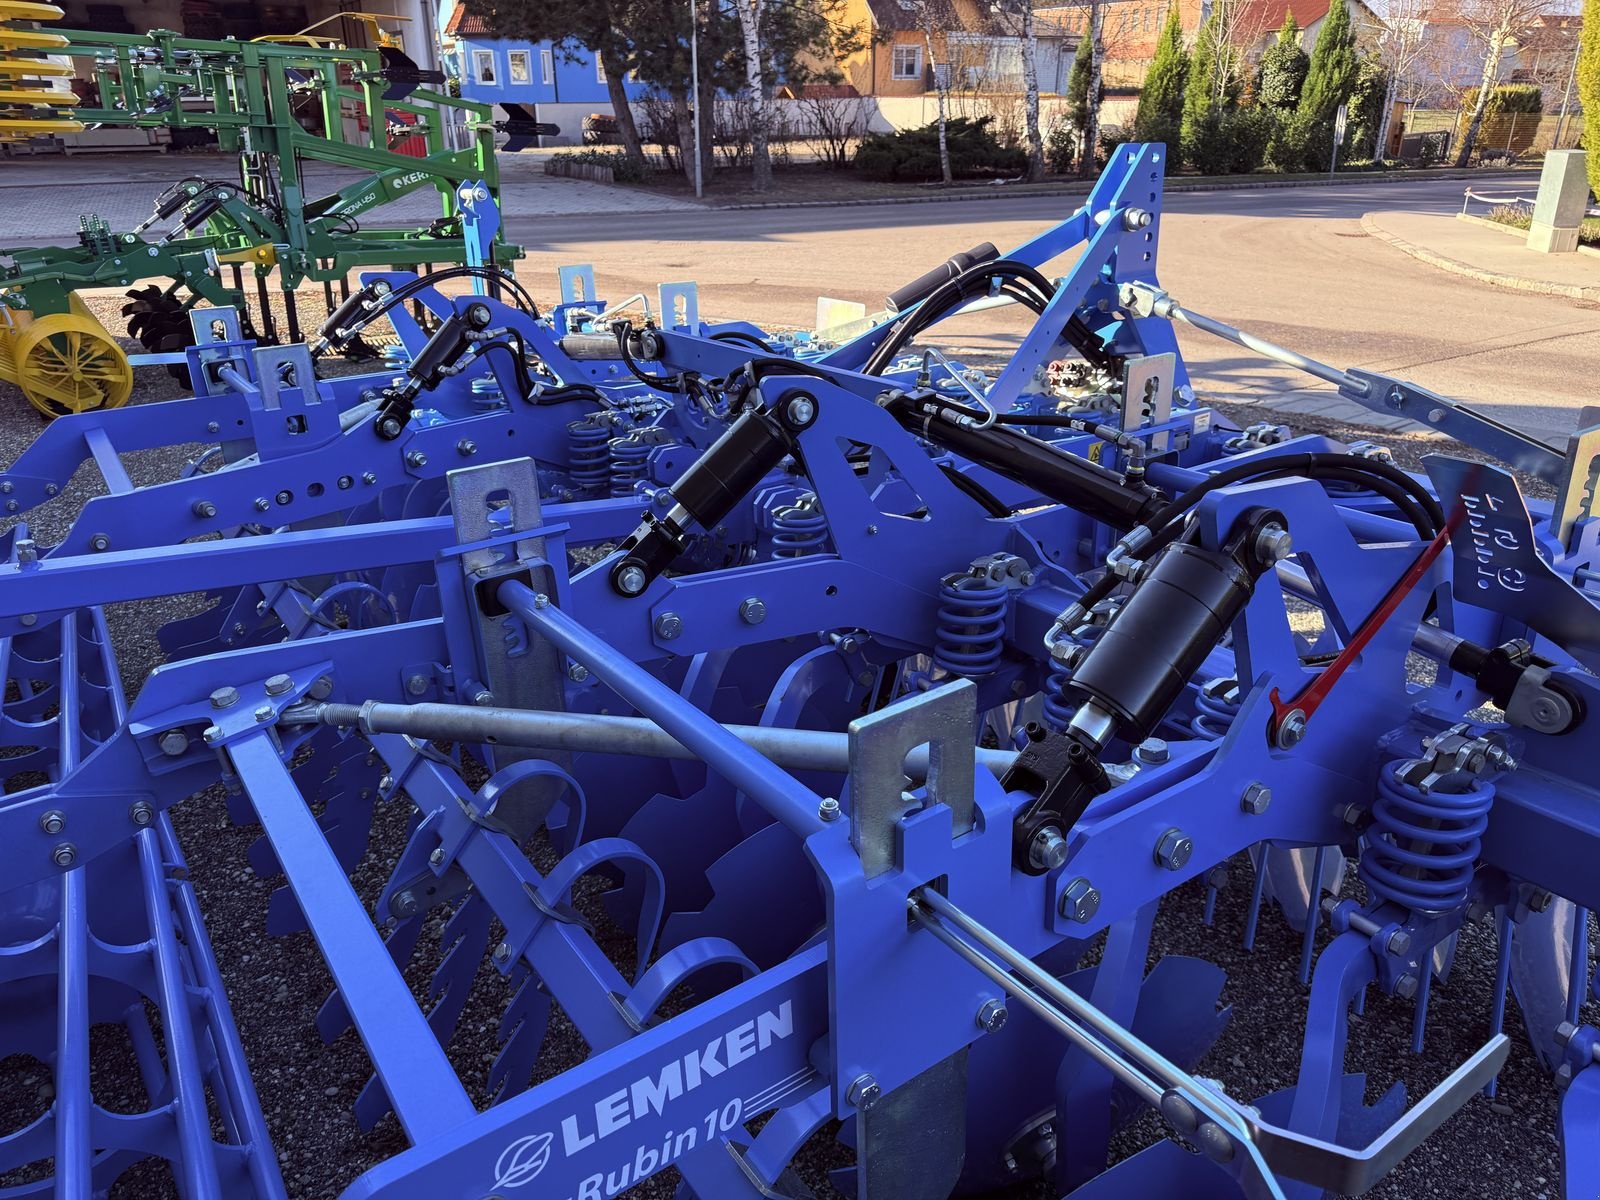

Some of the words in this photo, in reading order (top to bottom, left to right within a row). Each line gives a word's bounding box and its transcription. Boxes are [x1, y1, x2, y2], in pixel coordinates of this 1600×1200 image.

[361, 192, 376, 204] 450
[559, 999, 794, 1158] LEMKEN
[577, 1123, 698, 1200] Rubin
[704, 1097, 743, 1142] 10
